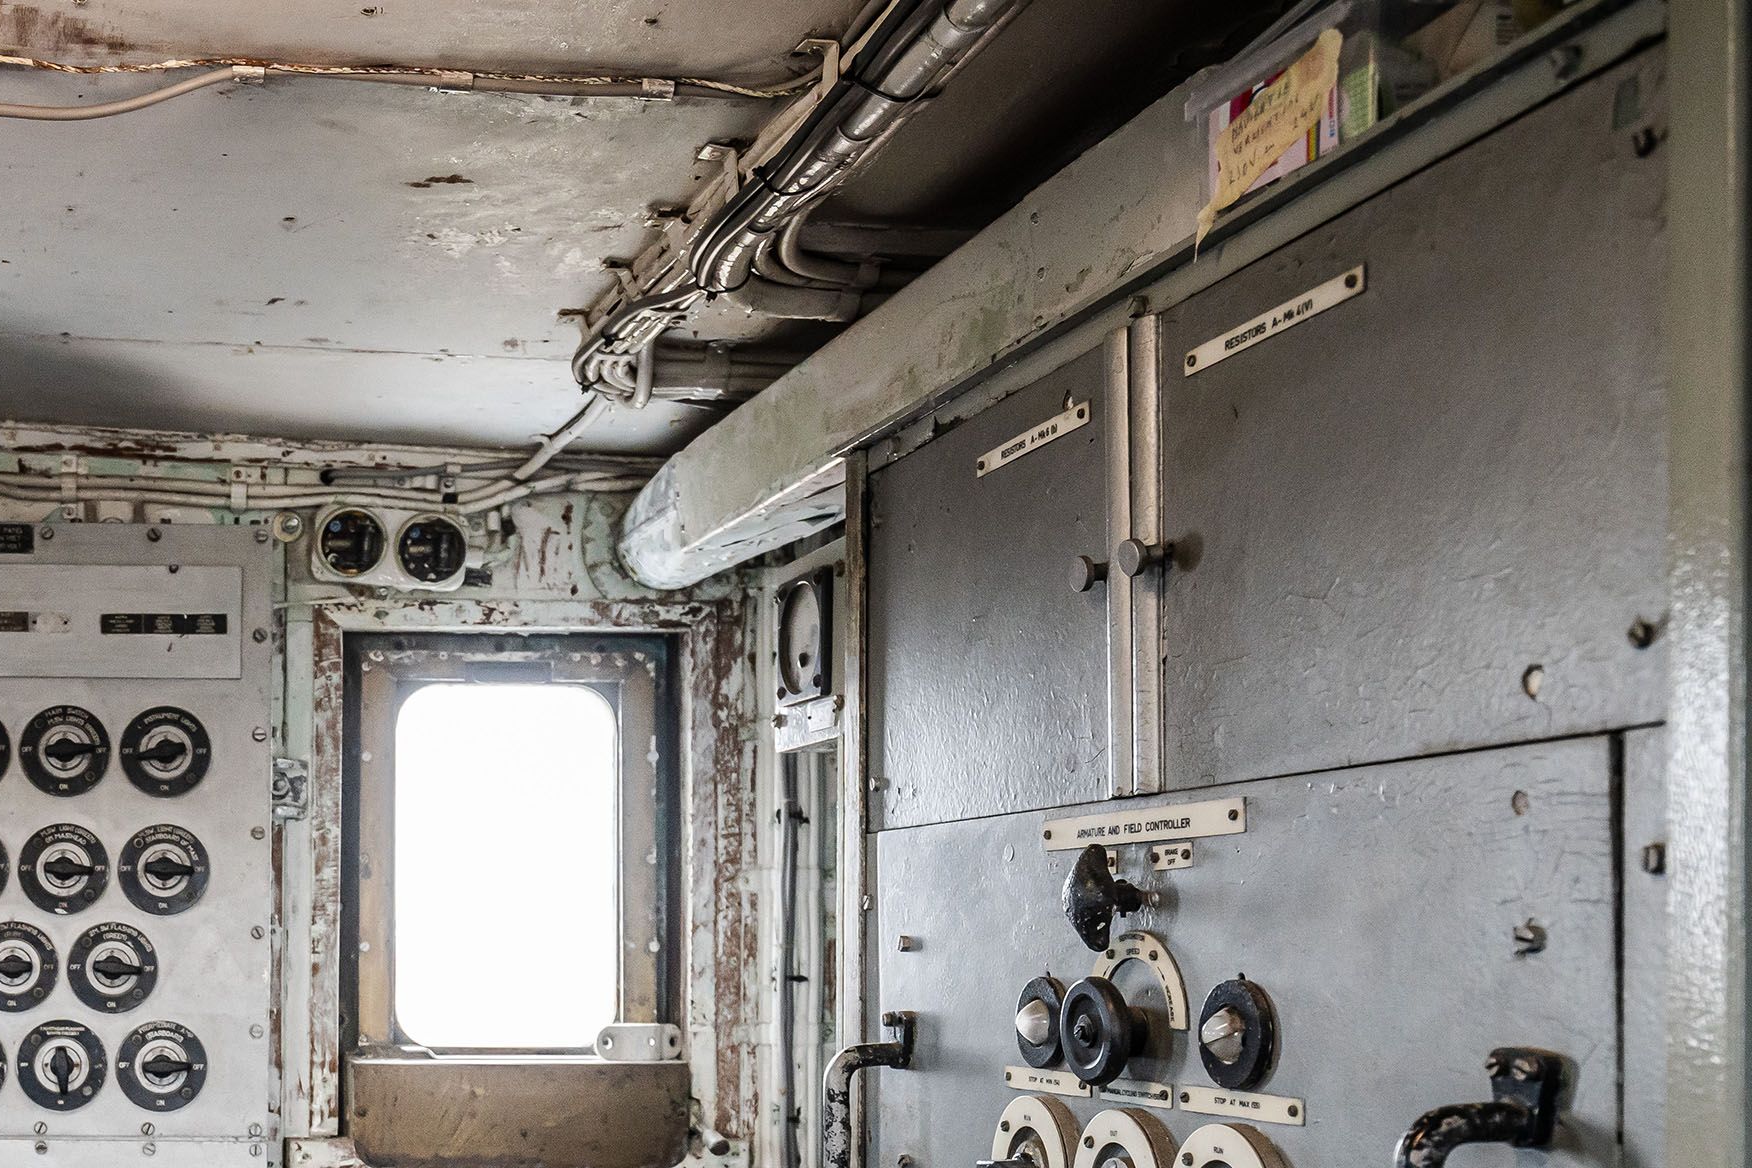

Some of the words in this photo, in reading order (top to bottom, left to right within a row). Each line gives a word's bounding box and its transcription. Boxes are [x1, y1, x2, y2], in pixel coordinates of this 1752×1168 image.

[1224, 322, 1267, 351] RESISTORS
[1001, 439, 1027, 460] RESISTORS
[1077, 825, 1106, 840] ARMATURE
[1107, 826, 1120, 836] AND
[1123, 823, 1143, 835] FIELD
[1145, 818, 1191, 832] CONTROLLER
[1164, 849, 1179, 857] BRAKE
[1167, 858, 1176, 866] OFF
[1214, 1096, 1226, 1108] STOP
[1229, 1098, 1236, 1108] AT
[1213, 1146, 1224, 1155] RUN
